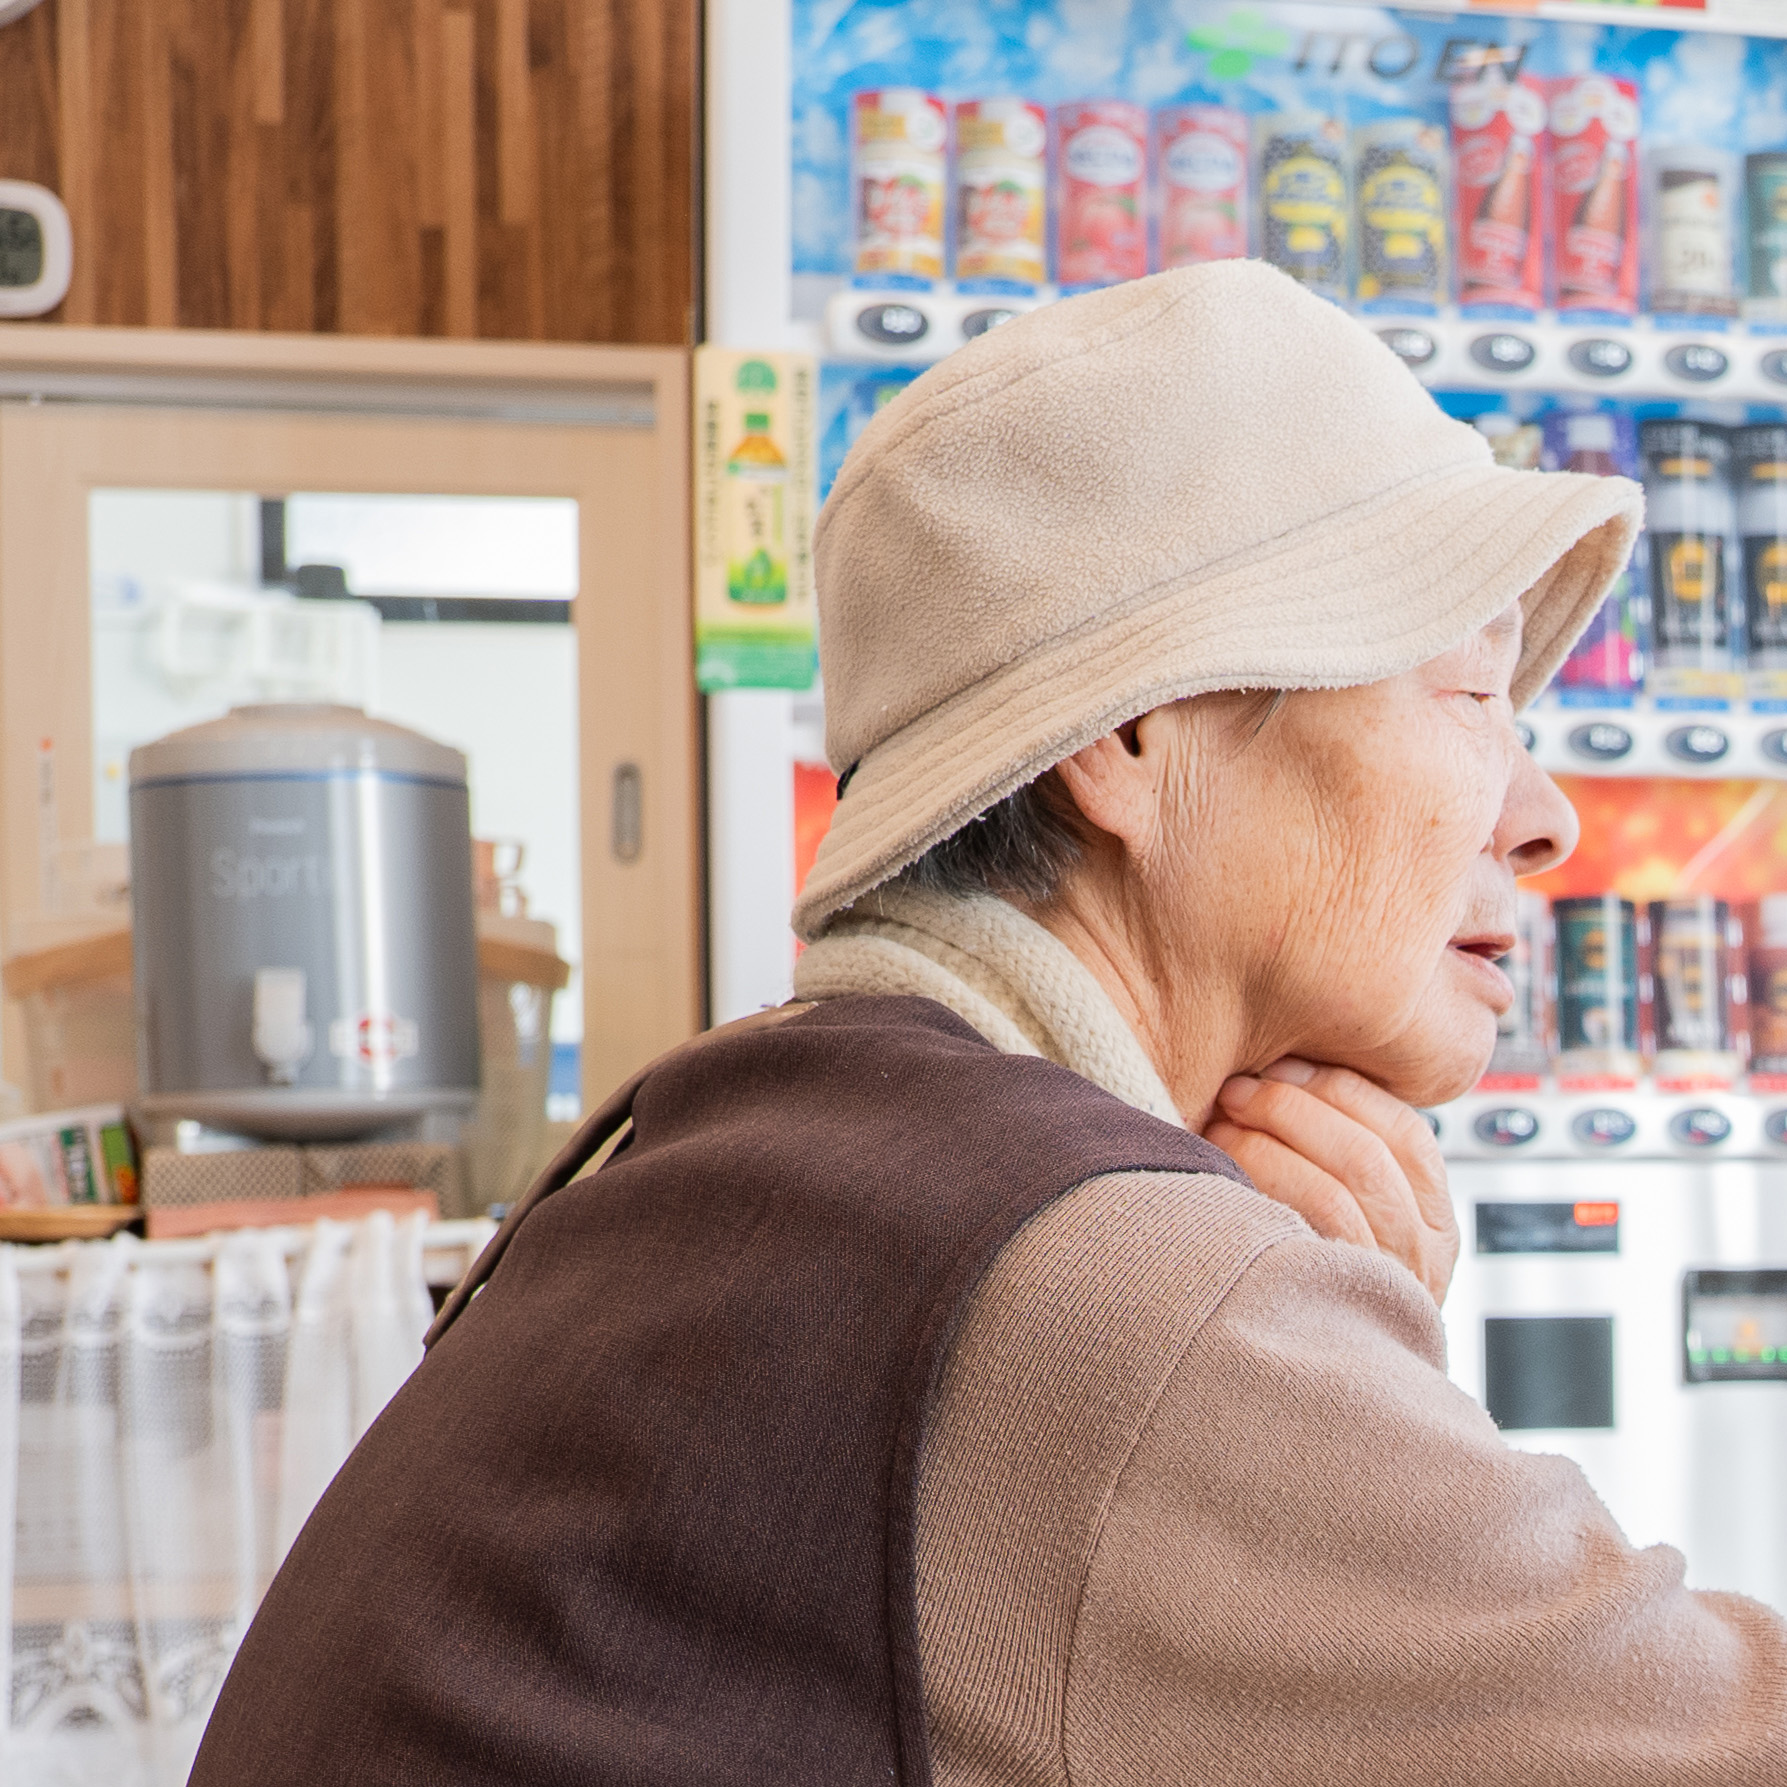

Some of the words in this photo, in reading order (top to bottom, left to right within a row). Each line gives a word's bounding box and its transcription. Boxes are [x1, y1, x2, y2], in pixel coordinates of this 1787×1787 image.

[1293, 30, 1419, 80] ITO
[1433, 36, 1529, 84] EN
[210, 847, 338, 904] Sport
